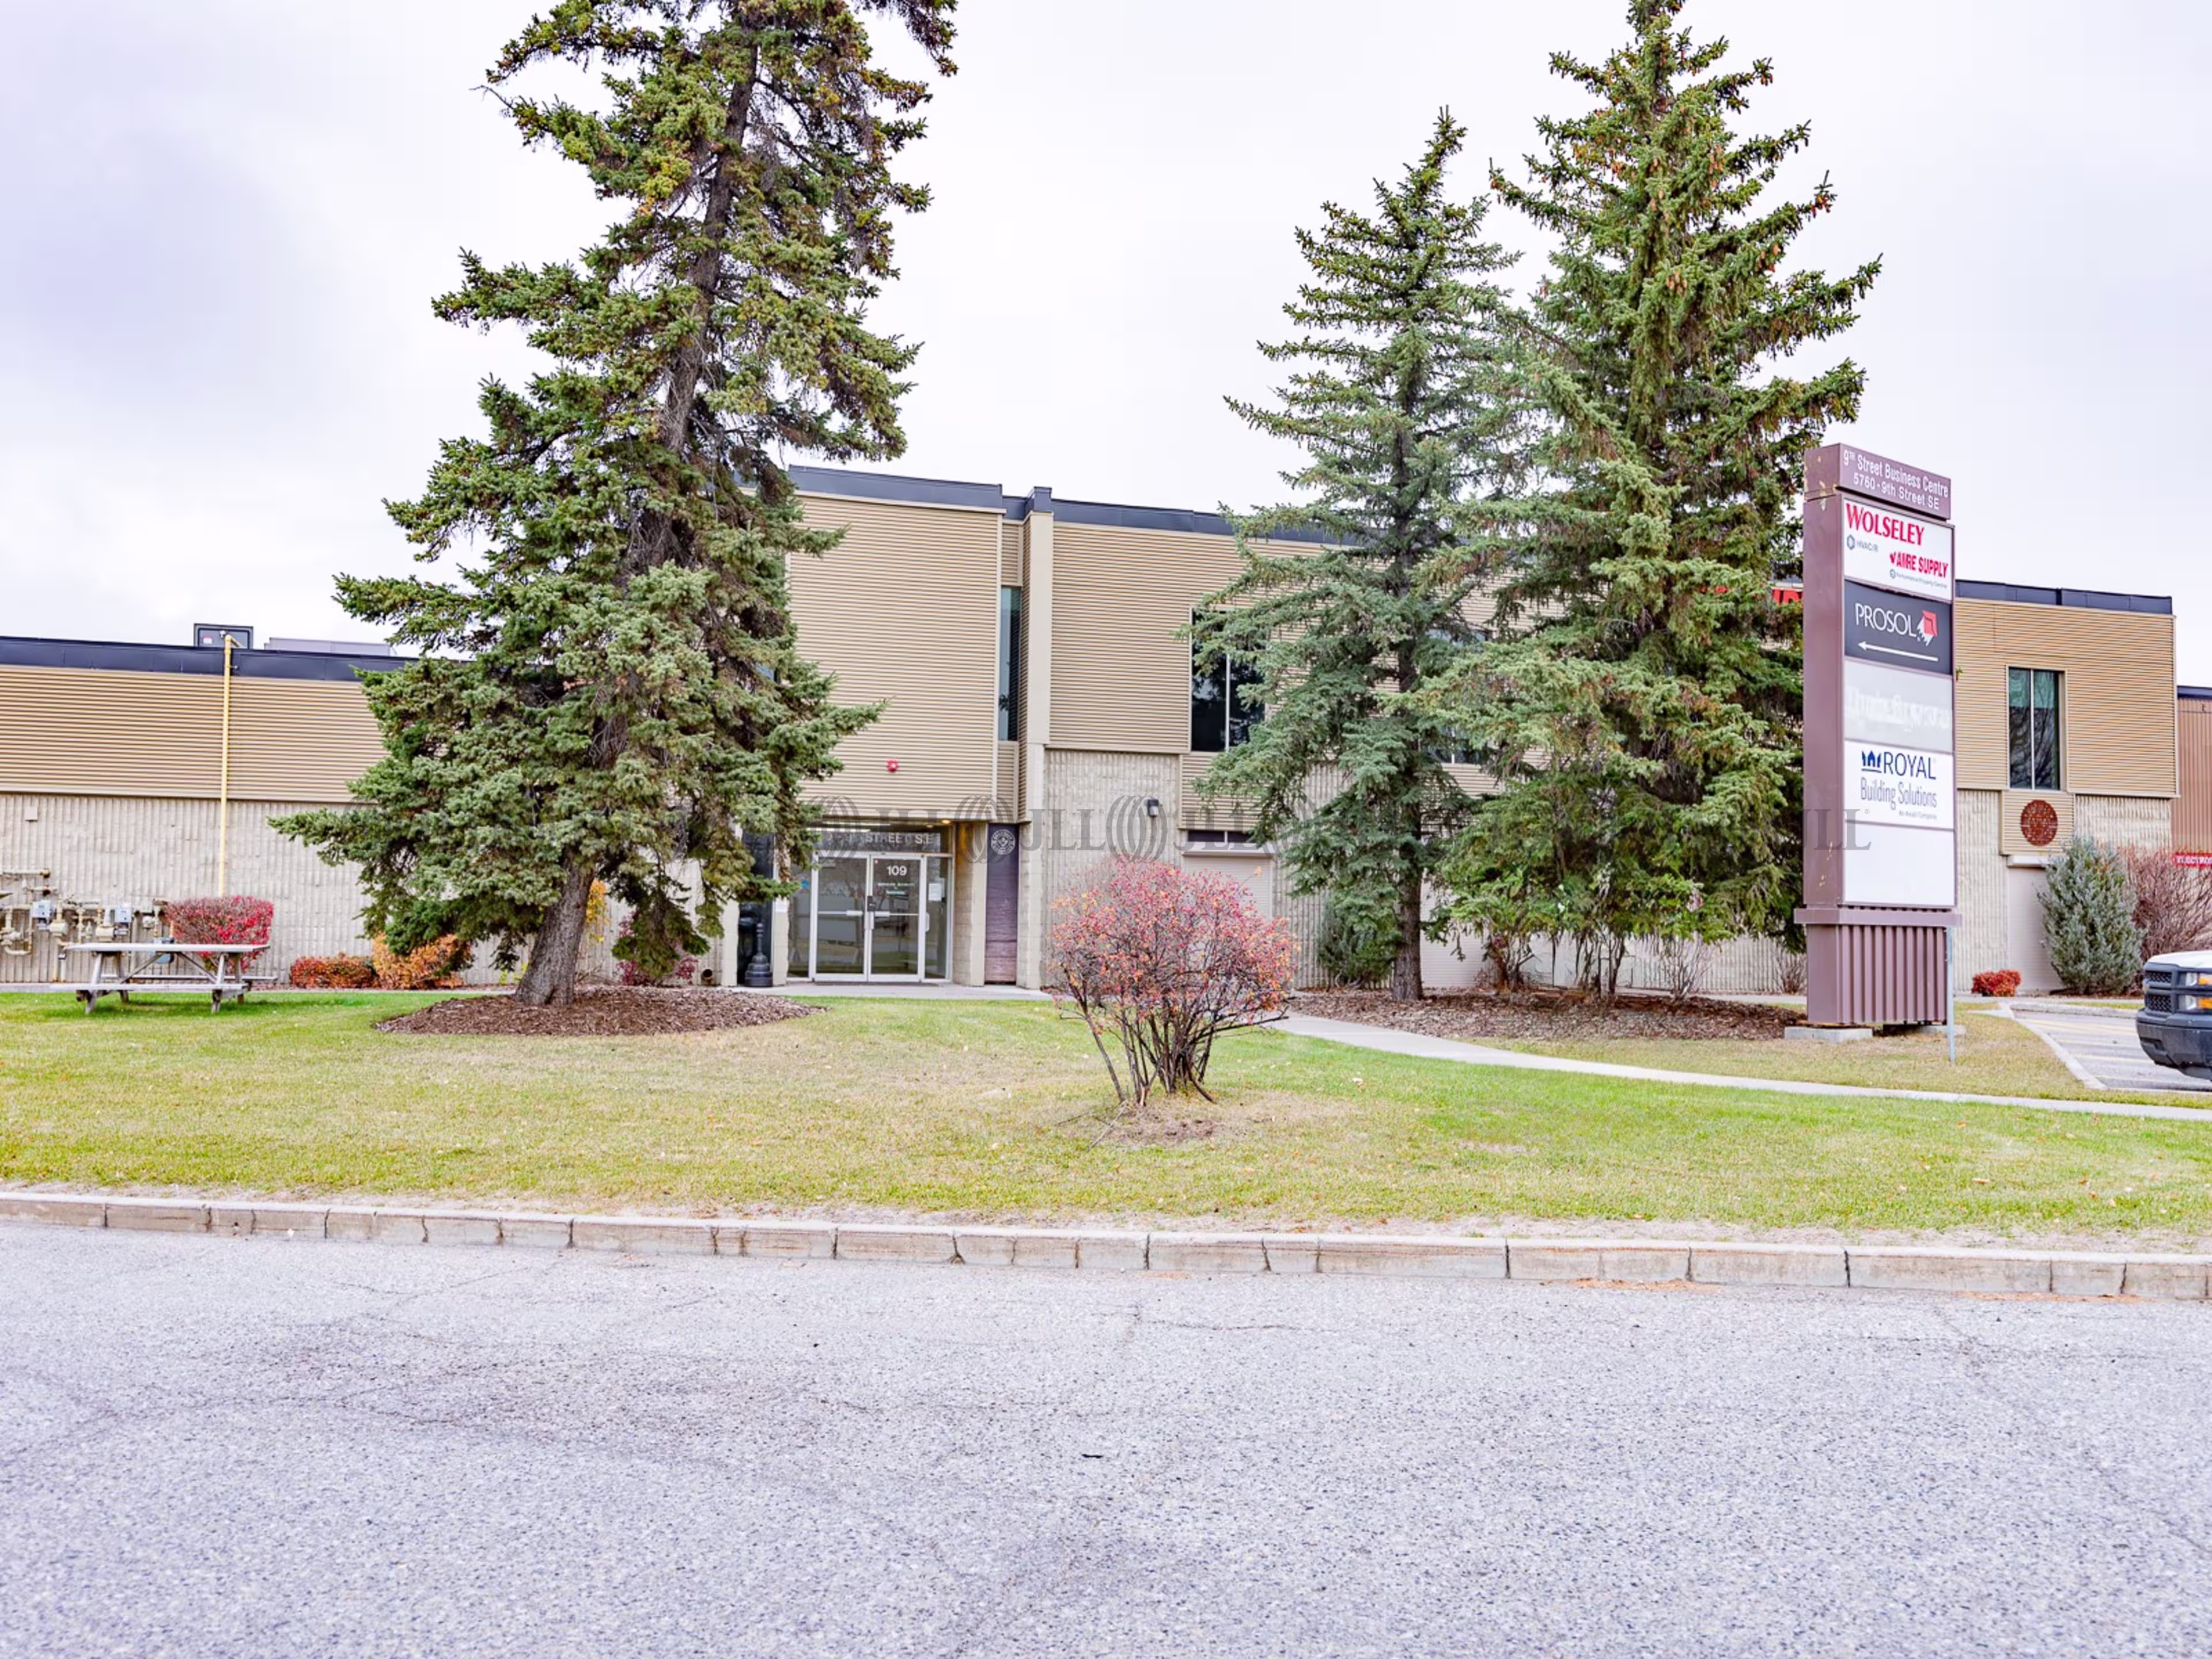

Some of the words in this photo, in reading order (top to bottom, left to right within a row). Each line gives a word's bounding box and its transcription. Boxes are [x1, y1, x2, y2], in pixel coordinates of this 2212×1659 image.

[1853, 472, 1875, 490] 5760
[1881, 481, 1896, 497] 9th
[1899, 486, 1925, 506] Street
[1927, 496, 1940, 510] SE
[1857, 454, 1883, 477] Street
[1885, 463, 1921, 489] Business
[1922, 475, 1949, 498] Centre
[1846, 503, 1925, 546] WOLSELEY
[1918, 556, 1948, 578] SUPPLY
[1855, 603, 1916, 638] PROSOL
[1884, 751, 1936, 780] ROYAL
[1861, 777, 1896, 810] Building
[1897, 781, 1937, 808] Solutions
[886, 865, 907, 876] 109
